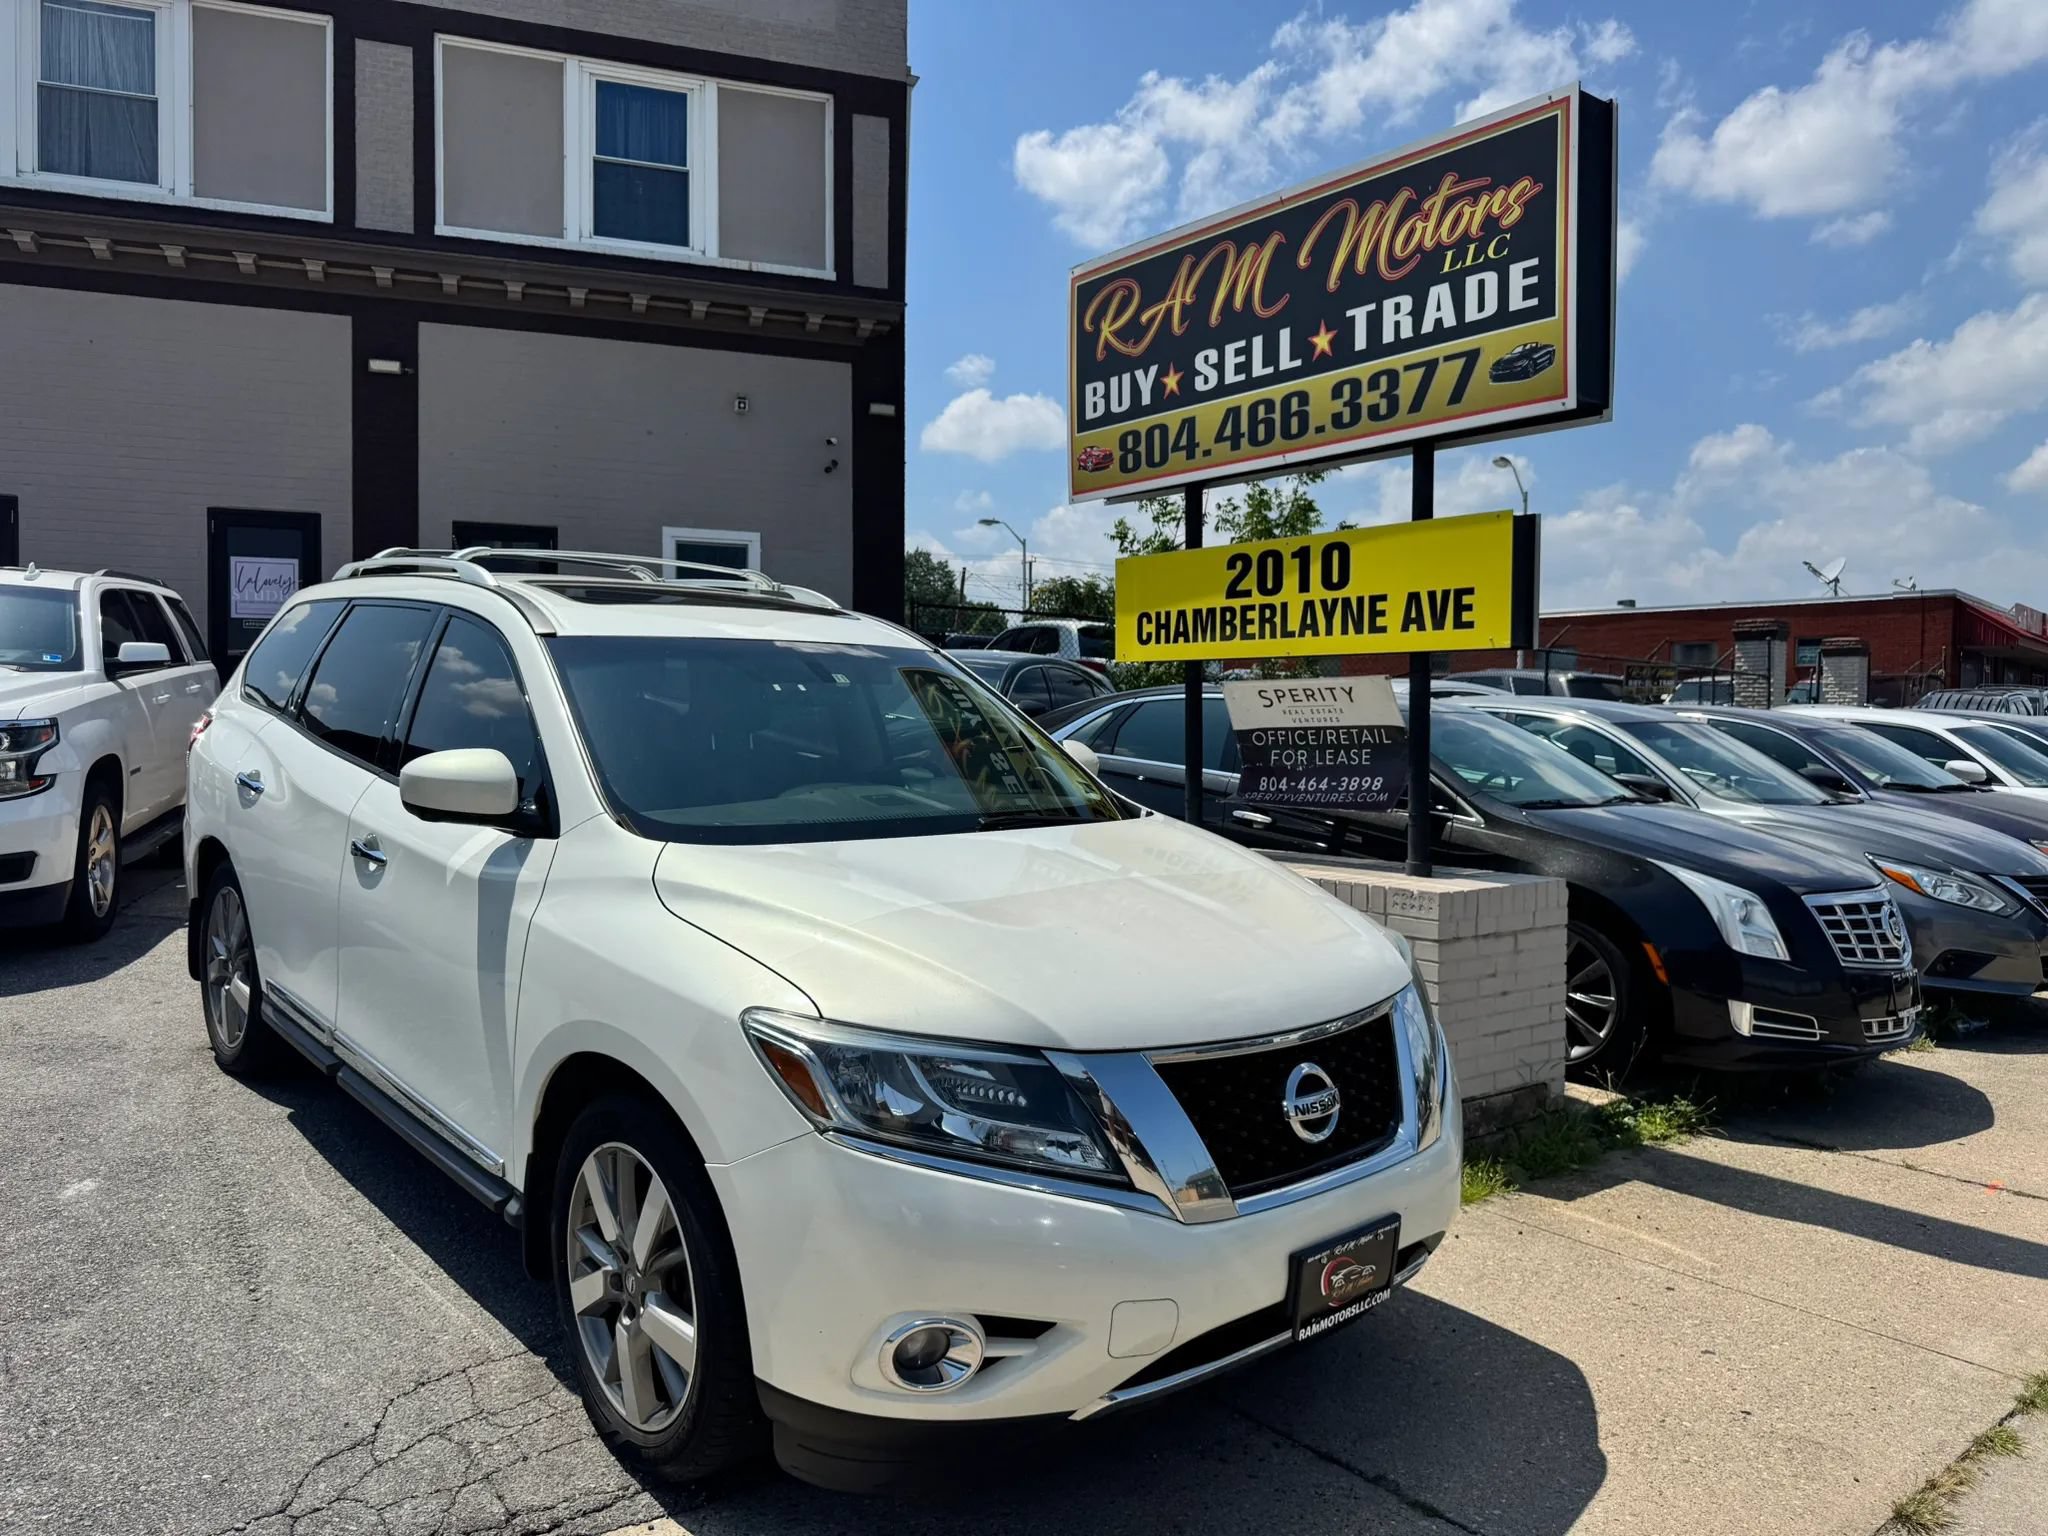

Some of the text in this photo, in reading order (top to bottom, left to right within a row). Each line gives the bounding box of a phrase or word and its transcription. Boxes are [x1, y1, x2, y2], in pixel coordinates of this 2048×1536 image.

[1439, 233, 1511, 274] LLC
[1084, 172, 1543, 361] RAM Motors
[1085, 257, 1539, 421] BUY SELL TRADE
[1118, 346, 1481, 474] 804.466.3377
[1225, 541, 1351, 599] 2010
[1137, 586, 1475, 646] CHAMBERLAYNE AVE
[1258, 686, 1355, 708] SPERITY
[1310, 707, 1344, 715] ESTATE
[1252, 728, 1392, 746] OFFICE/RETAIL
[1270, 749, 1371, 766] FOR LEASE
[1259, 776, 1383, 792] 804-464-3898
[1243, 791, 1389, 804] SPERITYVENTURES.COM
[1294, 1091, 1339, 1116] NISSAN
